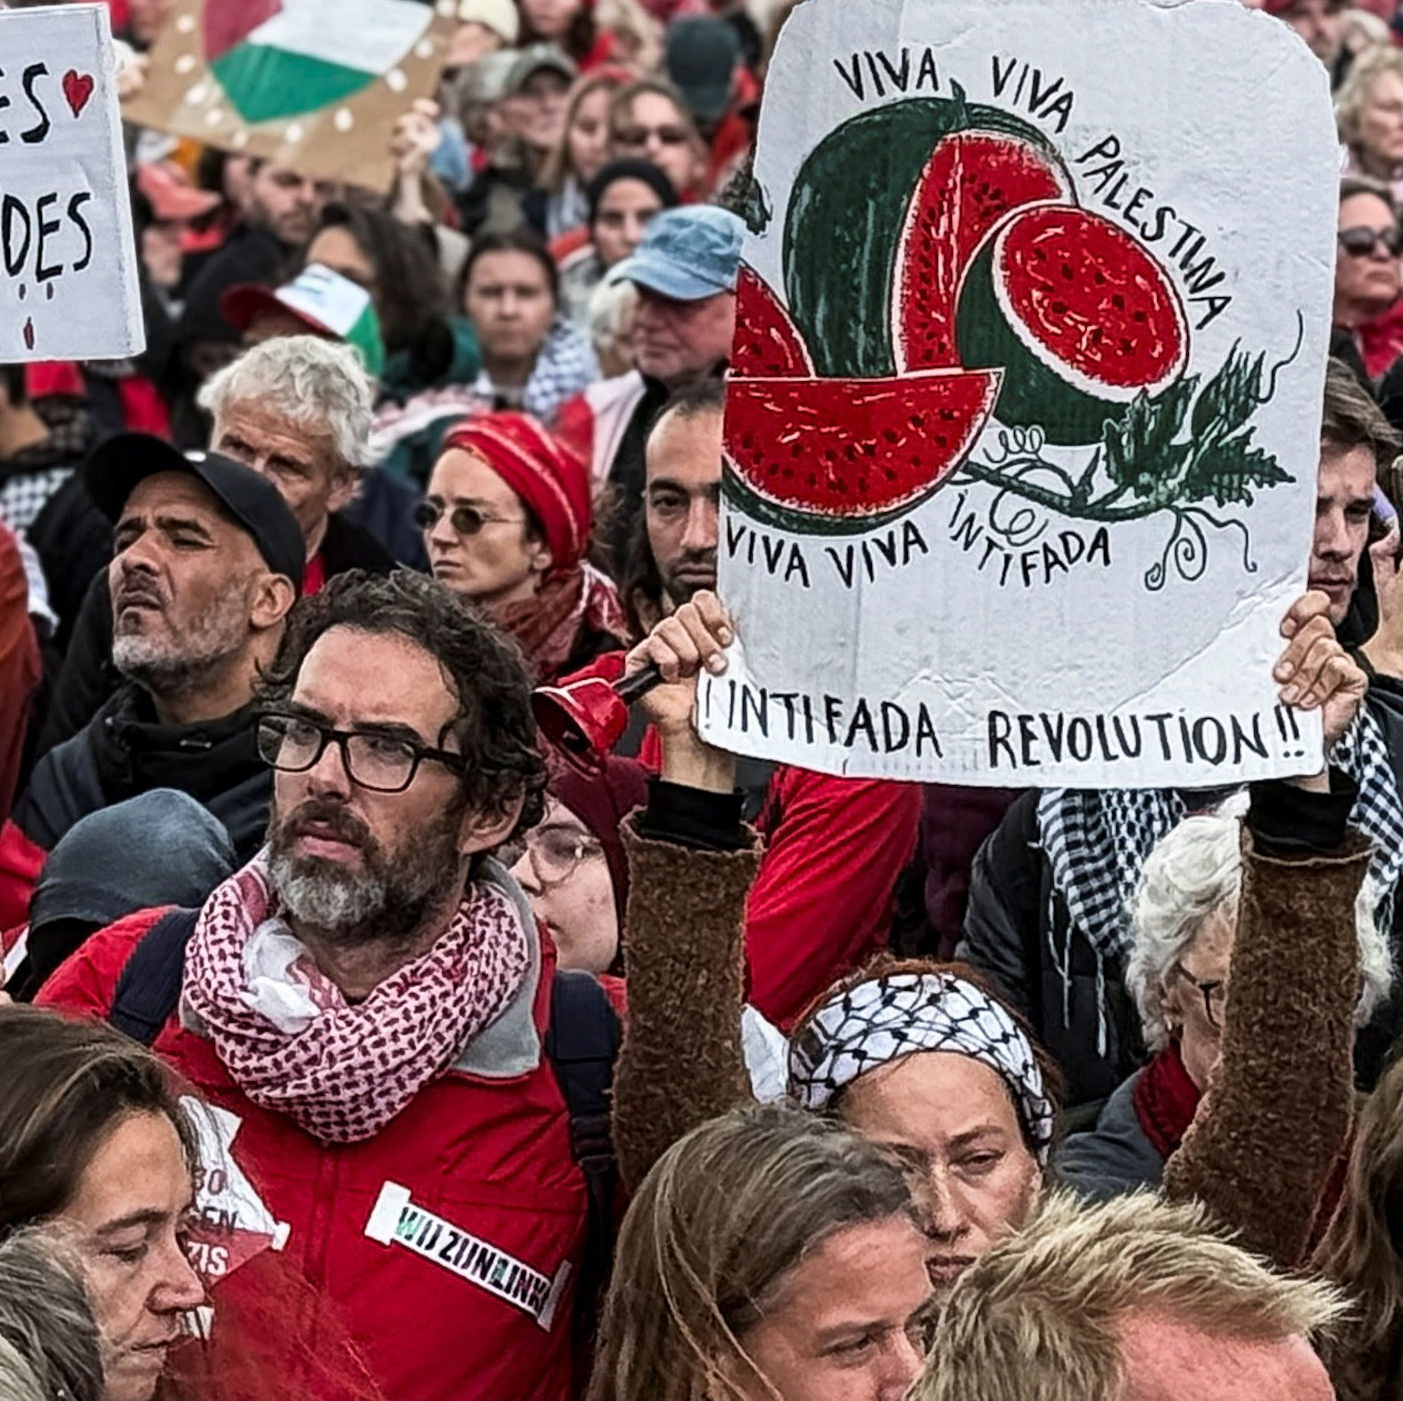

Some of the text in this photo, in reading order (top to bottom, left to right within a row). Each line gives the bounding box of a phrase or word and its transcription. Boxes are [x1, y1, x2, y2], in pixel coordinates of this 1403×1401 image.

[833, 46, 1233, 331] VIVA VIVA PALESTINA
[726, 490, 1112, 589] VIVA VIVA INTIFADA
[395, 1206, 444, 1251] WIJ
